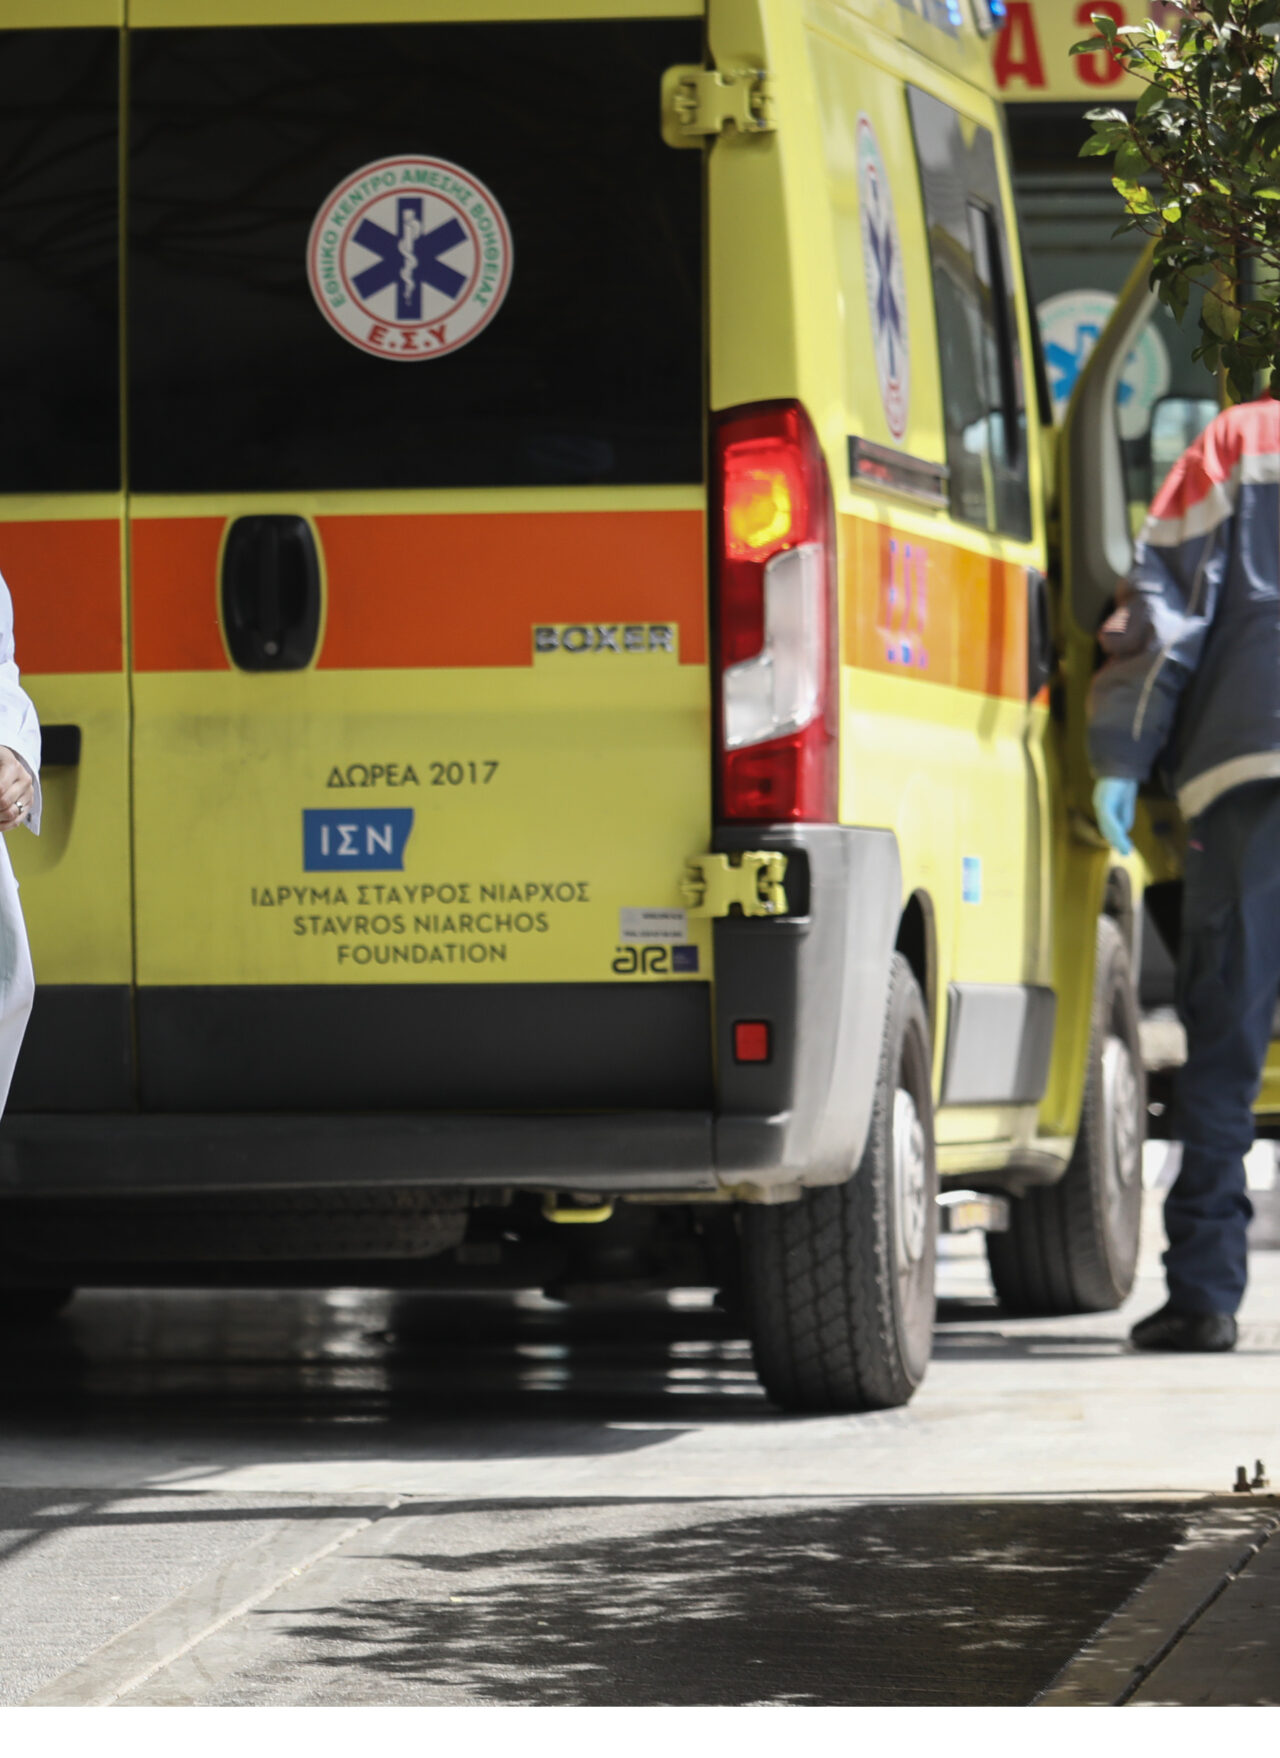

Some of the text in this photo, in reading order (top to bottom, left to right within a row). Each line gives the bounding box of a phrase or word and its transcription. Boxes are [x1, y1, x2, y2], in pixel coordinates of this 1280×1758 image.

[320, 169, 500, 308] ΕΘΝΙΚΟ ΚΕΝΤΡΟ ΑΜΕΣΗΣ ΒΟΗΘΕΙΑΣ
[535, 625, 675, 653] BOXER
[326, 760, 499, 788] ΔΩΡΕΑ 2017
[321, 824, 393, 856] ΙΣΝ
[251, 881, 590, 907] ΙΔΡΥΜΑ ΣΤΑΥΡΟΣ ΝΙΑΡΧΟΣ
[293, 912, 550, 936] STAVROS NIARCHOS
[337, 943, 508, 965] FOUNDATION
